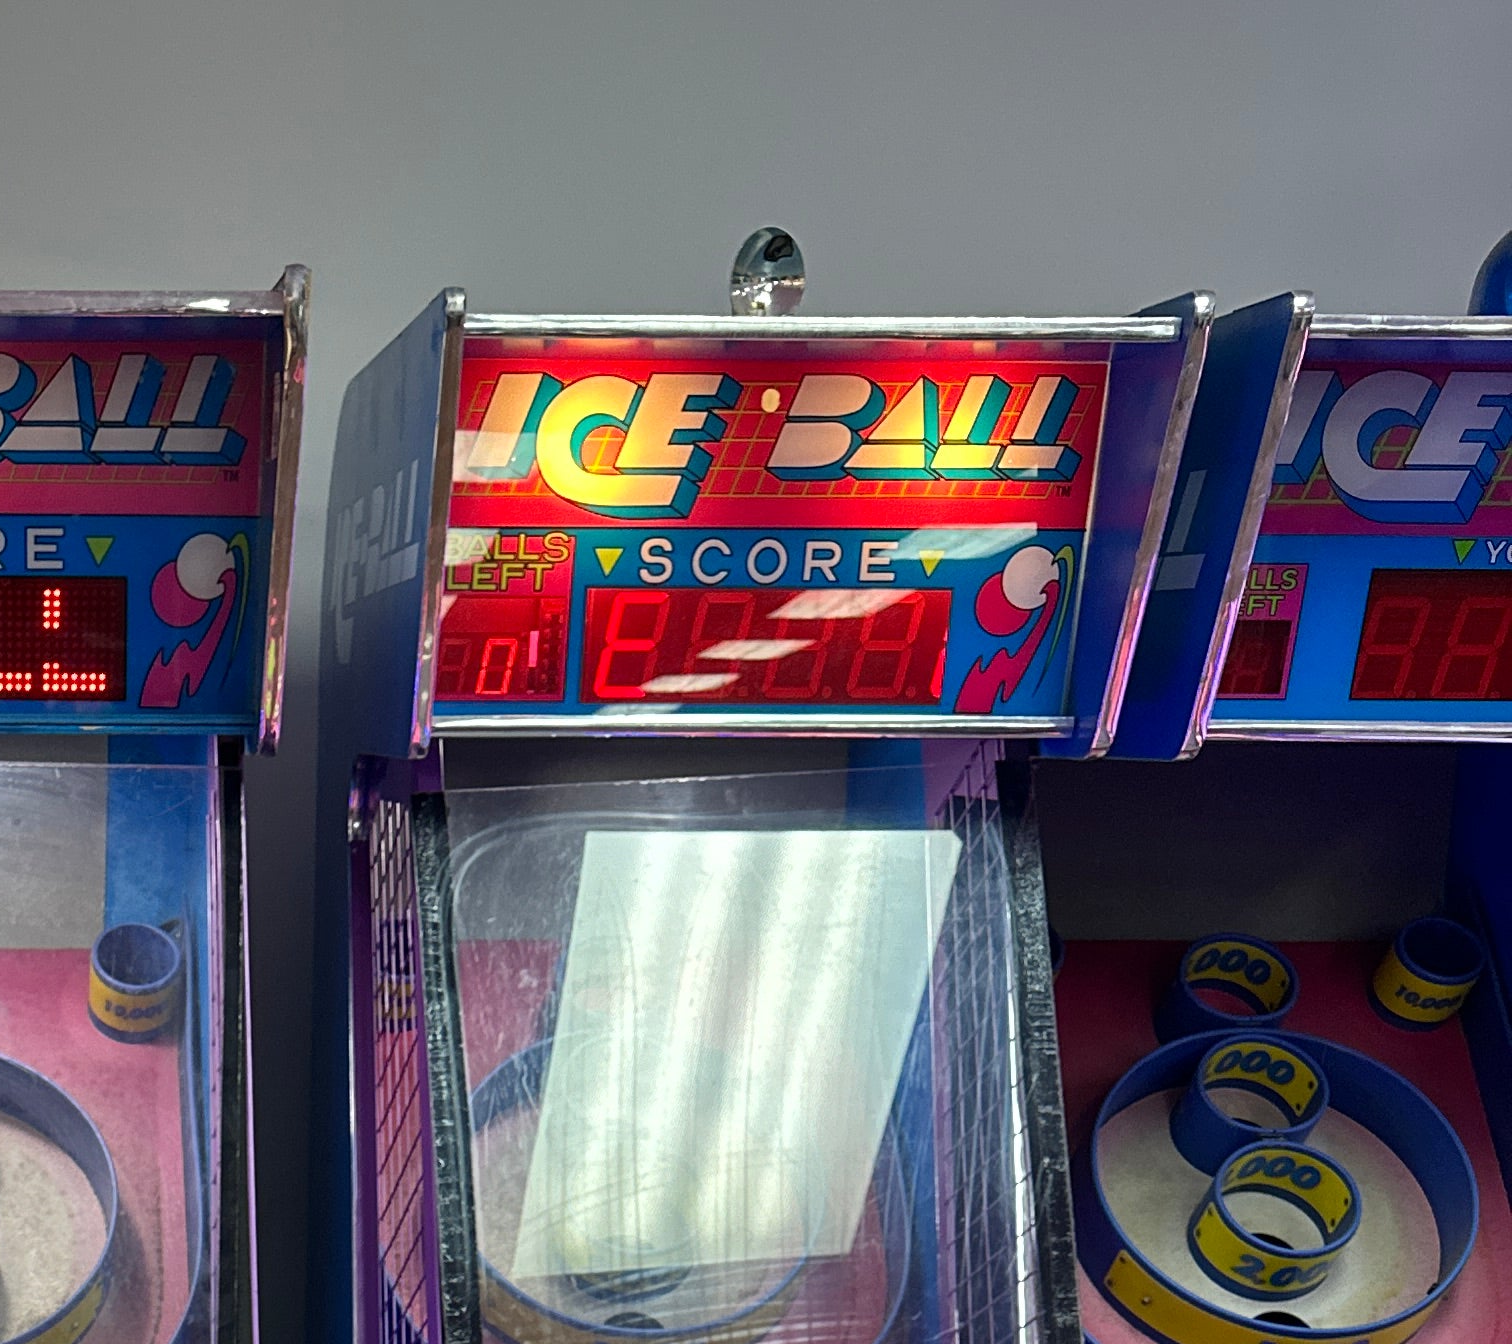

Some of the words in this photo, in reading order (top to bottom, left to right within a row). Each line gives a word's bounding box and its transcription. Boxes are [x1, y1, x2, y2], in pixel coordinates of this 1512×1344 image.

[467, 371, 743, 520] ICE
[767, 374, 1083, 482] BALL
[444, 530, 570, 565] BALLS
[638, 537, 899, 583] SCORE
[446, 562, 554, 592] LEFT
